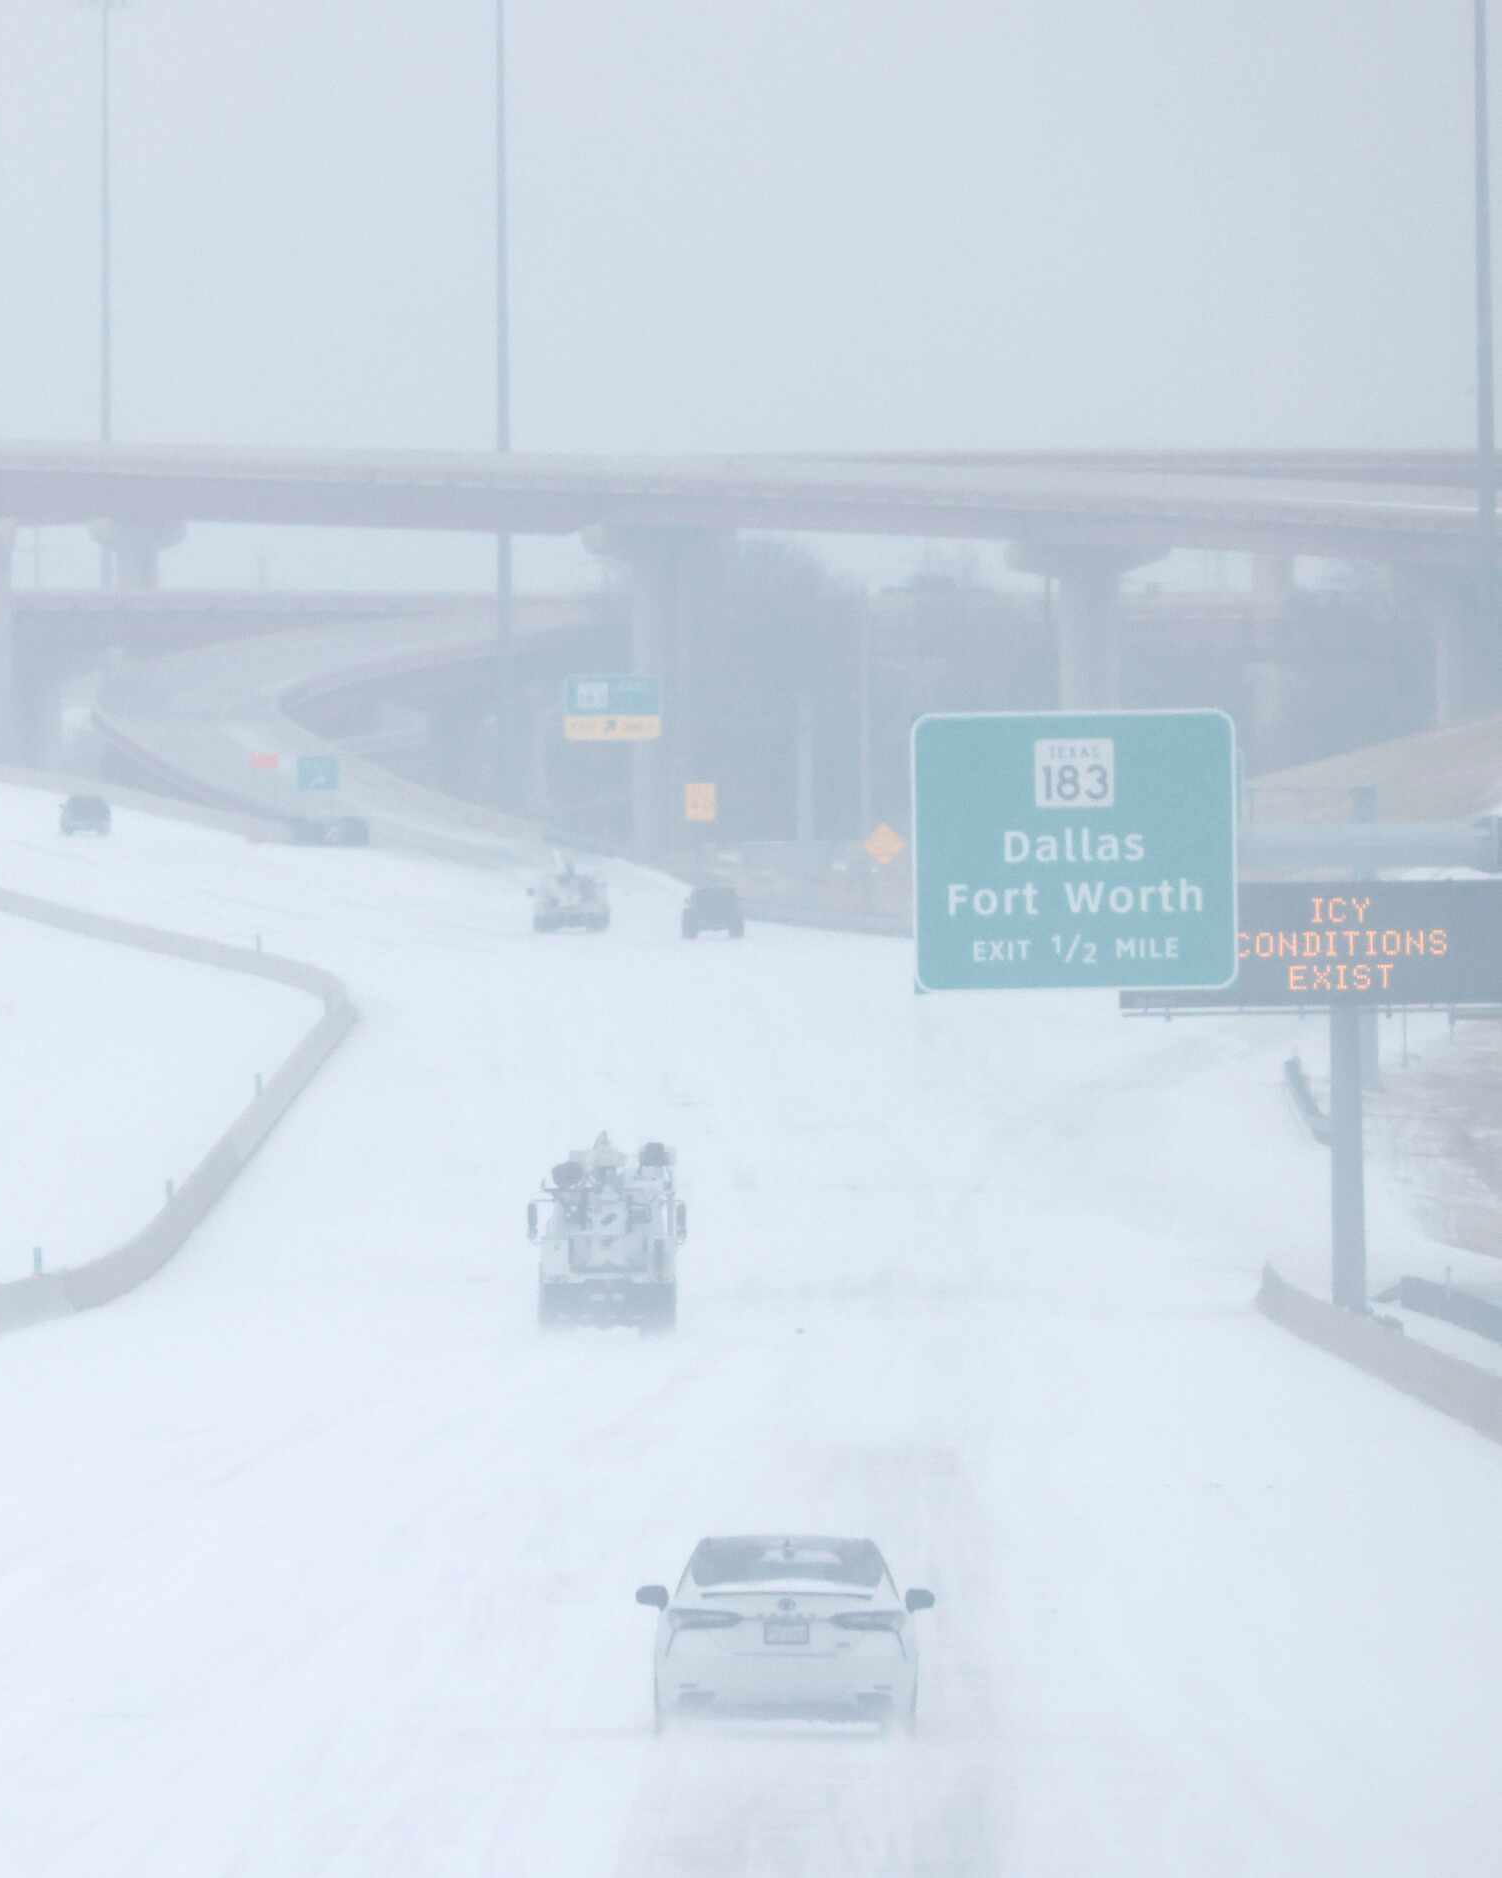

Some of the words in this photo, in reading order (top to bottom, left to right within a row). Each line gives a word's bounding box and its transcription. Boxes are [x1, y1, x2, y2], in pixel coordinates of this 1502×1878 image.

[1049, 744, 1100, 759] TEXAS
[1042, 764, 1108, 801] 183
[1003, 826, 1146, 864] Dallas
[946, 881, 1041, 916] Fort
[1062, 876, 1203, 914] Worth
[1311, 896, 1372, 925] ICY
[972, 938, 1033, 962] EXIT
[1050, 932, 1100, 965] 1/2
[1114, 936, 1180, 961] MILE
[1237, 928, 1449, 959] CONDITIONS
[1287, 963, 1395, 993] EXIST
